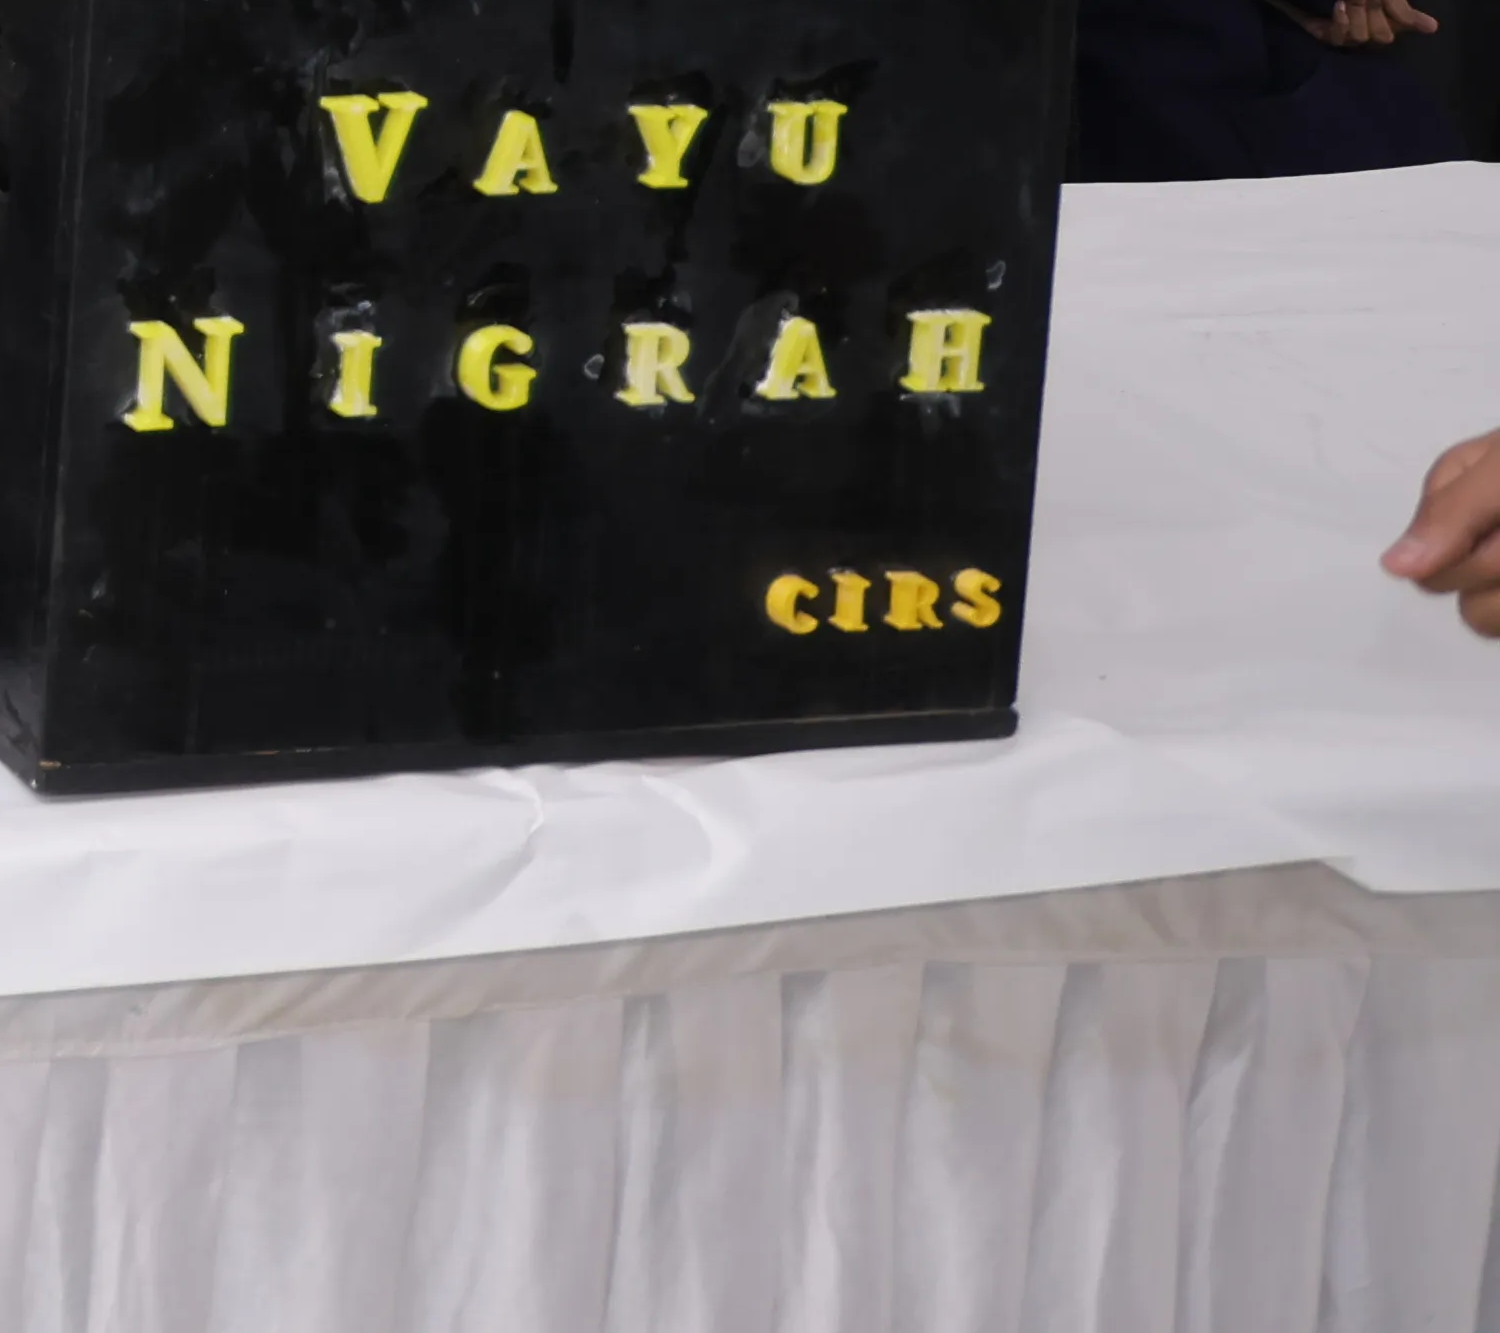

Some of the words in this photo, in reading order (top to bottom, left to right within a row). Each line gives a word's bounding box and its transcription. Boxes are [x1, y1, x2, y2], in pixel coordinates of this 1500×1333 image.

[320, 90, 849, 204] VAYU
[122, 310, 993, 433] NIGRAH
[766, 569, 1002, 634] CIRS
